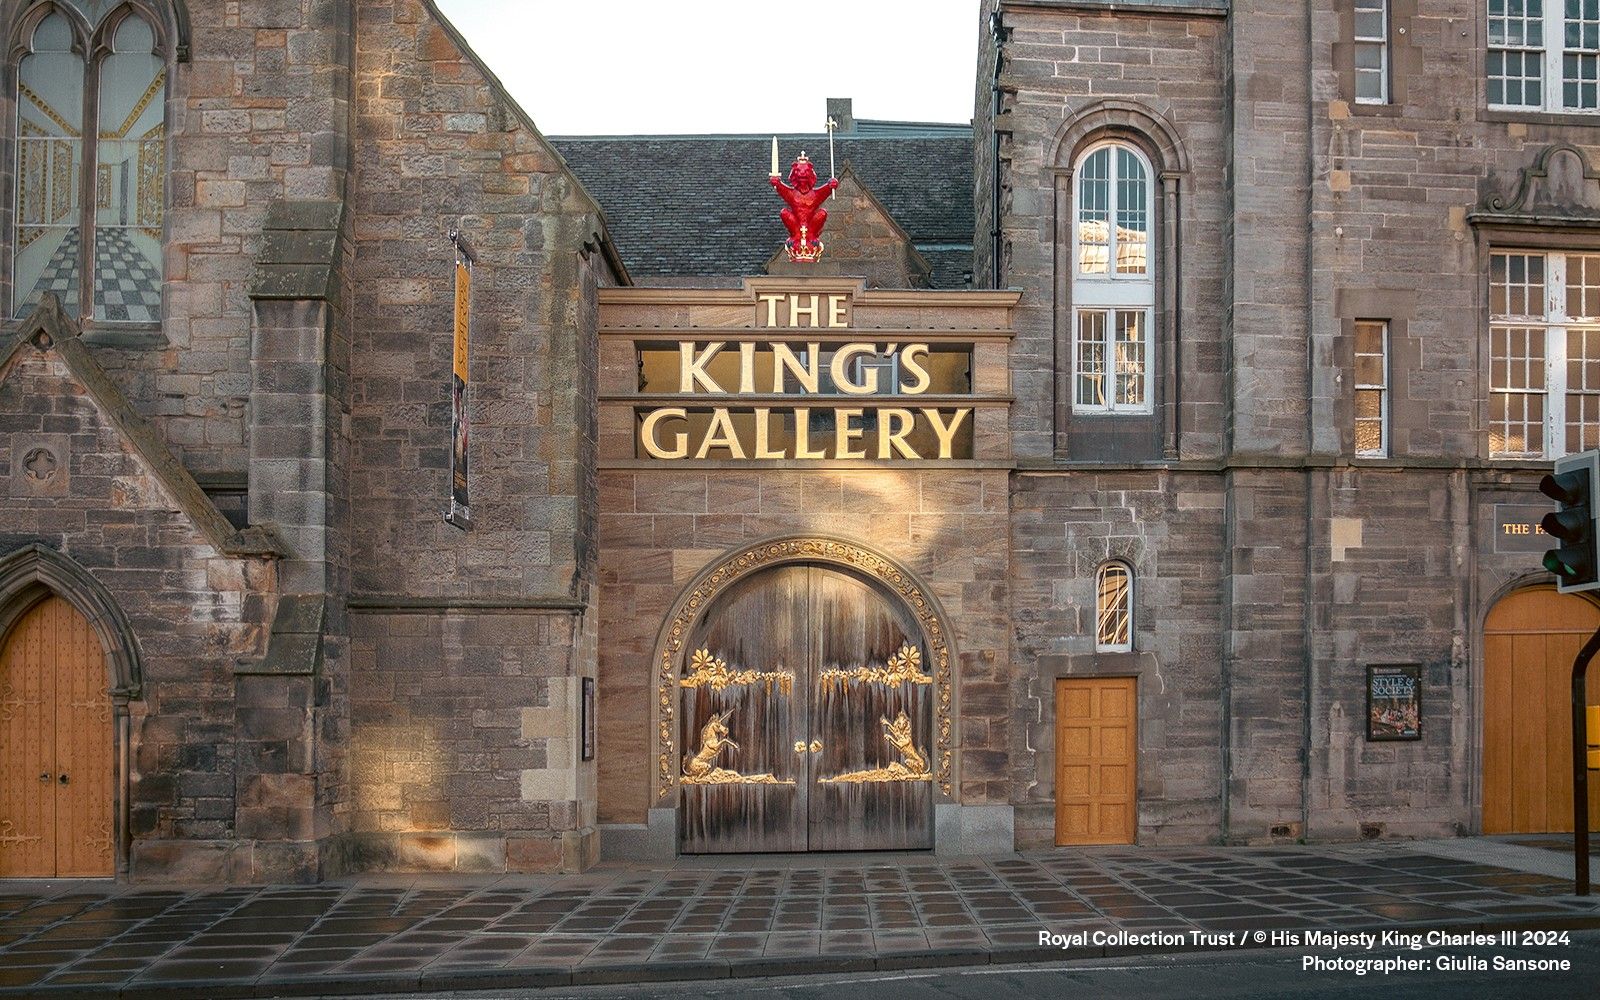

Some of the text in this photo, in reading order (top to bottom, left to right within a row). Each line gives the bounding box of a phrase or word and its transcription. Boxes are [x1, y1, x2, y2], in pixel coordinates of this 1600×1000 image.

[758, 294, 849, 328] THE
[679, 341, 931, 395] KING'S
[641, 406, 972, 460] GALLERY
[1502, 523, 1530, 535] THE
[1373, 677, 1415, 688] STYLE &
[1373, 686, 1415, 695] SOCIETY
